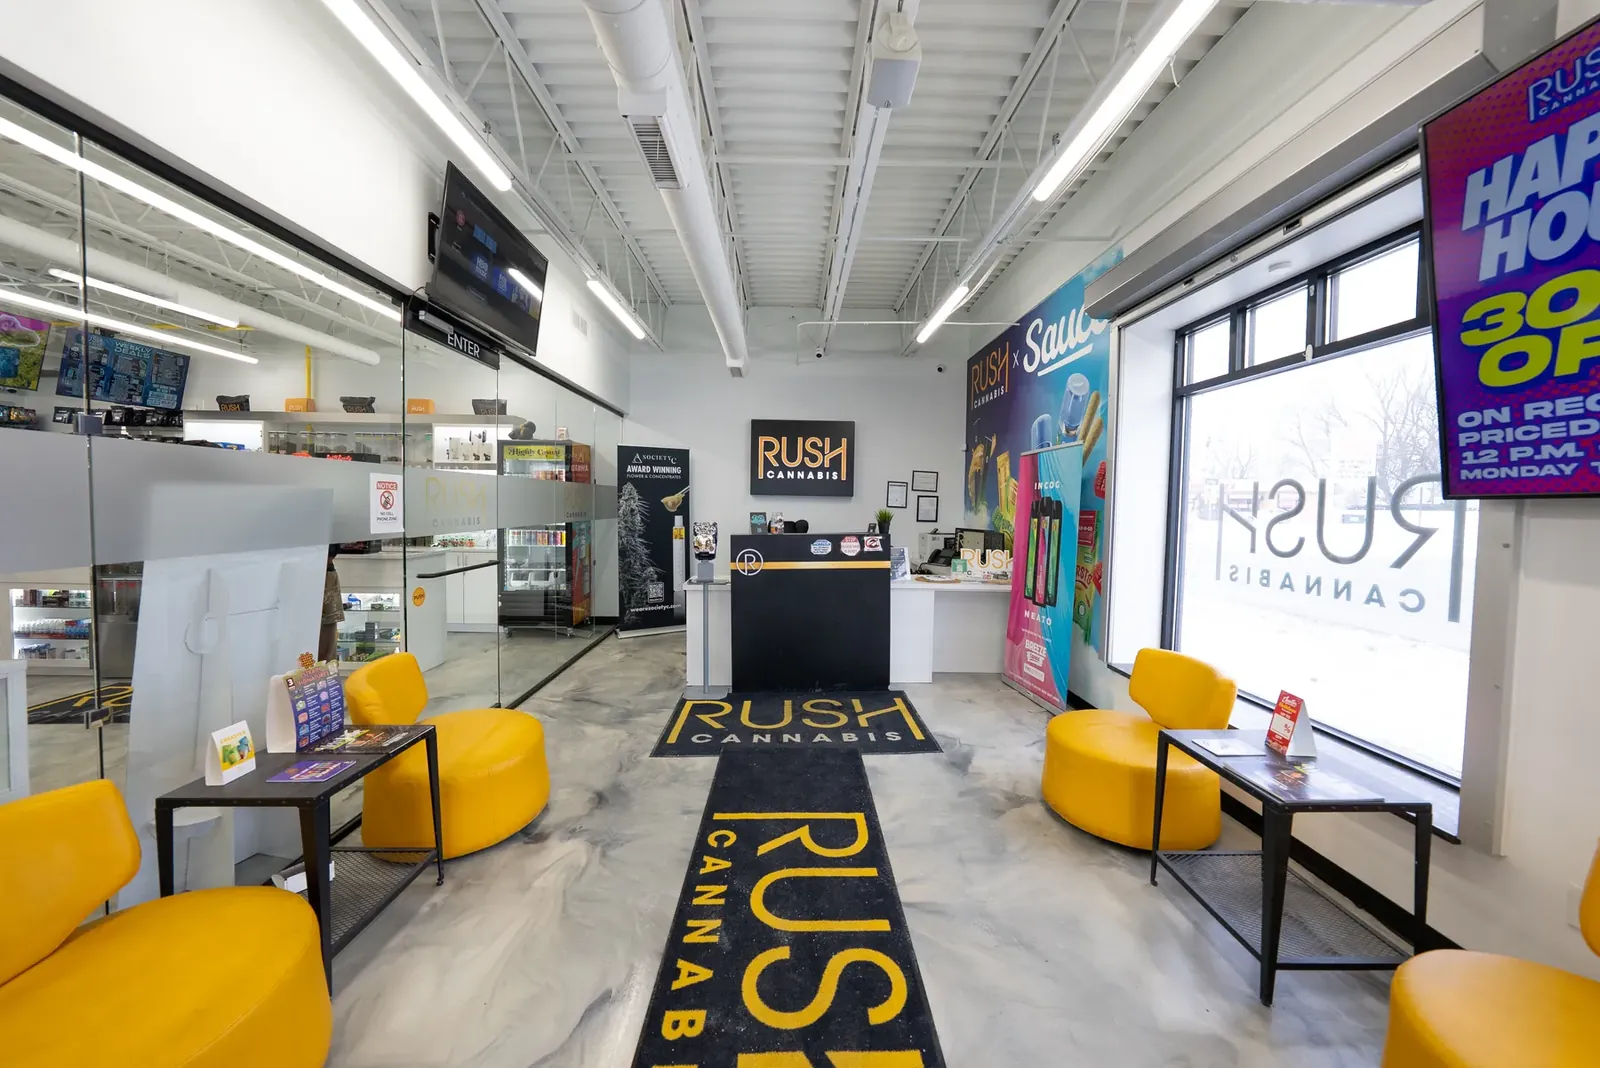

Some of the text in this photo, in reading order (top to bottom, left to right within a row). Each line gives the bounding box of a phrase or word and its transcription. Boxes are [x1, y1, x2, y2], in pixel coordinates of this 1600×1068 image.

[114, 348, 151, 359] DEALS
[115, 341, 152, 354] WEEKLY
[447, 332, 480, 358] ENTER
[971, 342, 1009, 411] RUSH
[973, 385, 1005, 409] CANNABIS
[220, 404, 240, 412] RUSH
[1457, 406, 1511, 428] ON
[1458, 418, 1600, 447] PRICED
[758, 435, 847, 480] RUSH
[1462, 449, 1499, 464] 12
[626, 464, 682, 474] AWARD WINNING
[766, 470, 839, 480] CANNABIS
[1460, 462, 1578, 480] MONDAY
[377, 481, 398, 490] NOTICE
[1034, 480, 1061, 490] INCOG
[1024, 610, 1052, 626] NEATO
[1025, 640, 1047, 657] BREEZE
[666, 697, 926, 744] RUSH
[691, 731, 903, 744] CANNABIS
[651, 829, 738, 1068] CANNAB
[713, 812, 925, 1068] RUS
